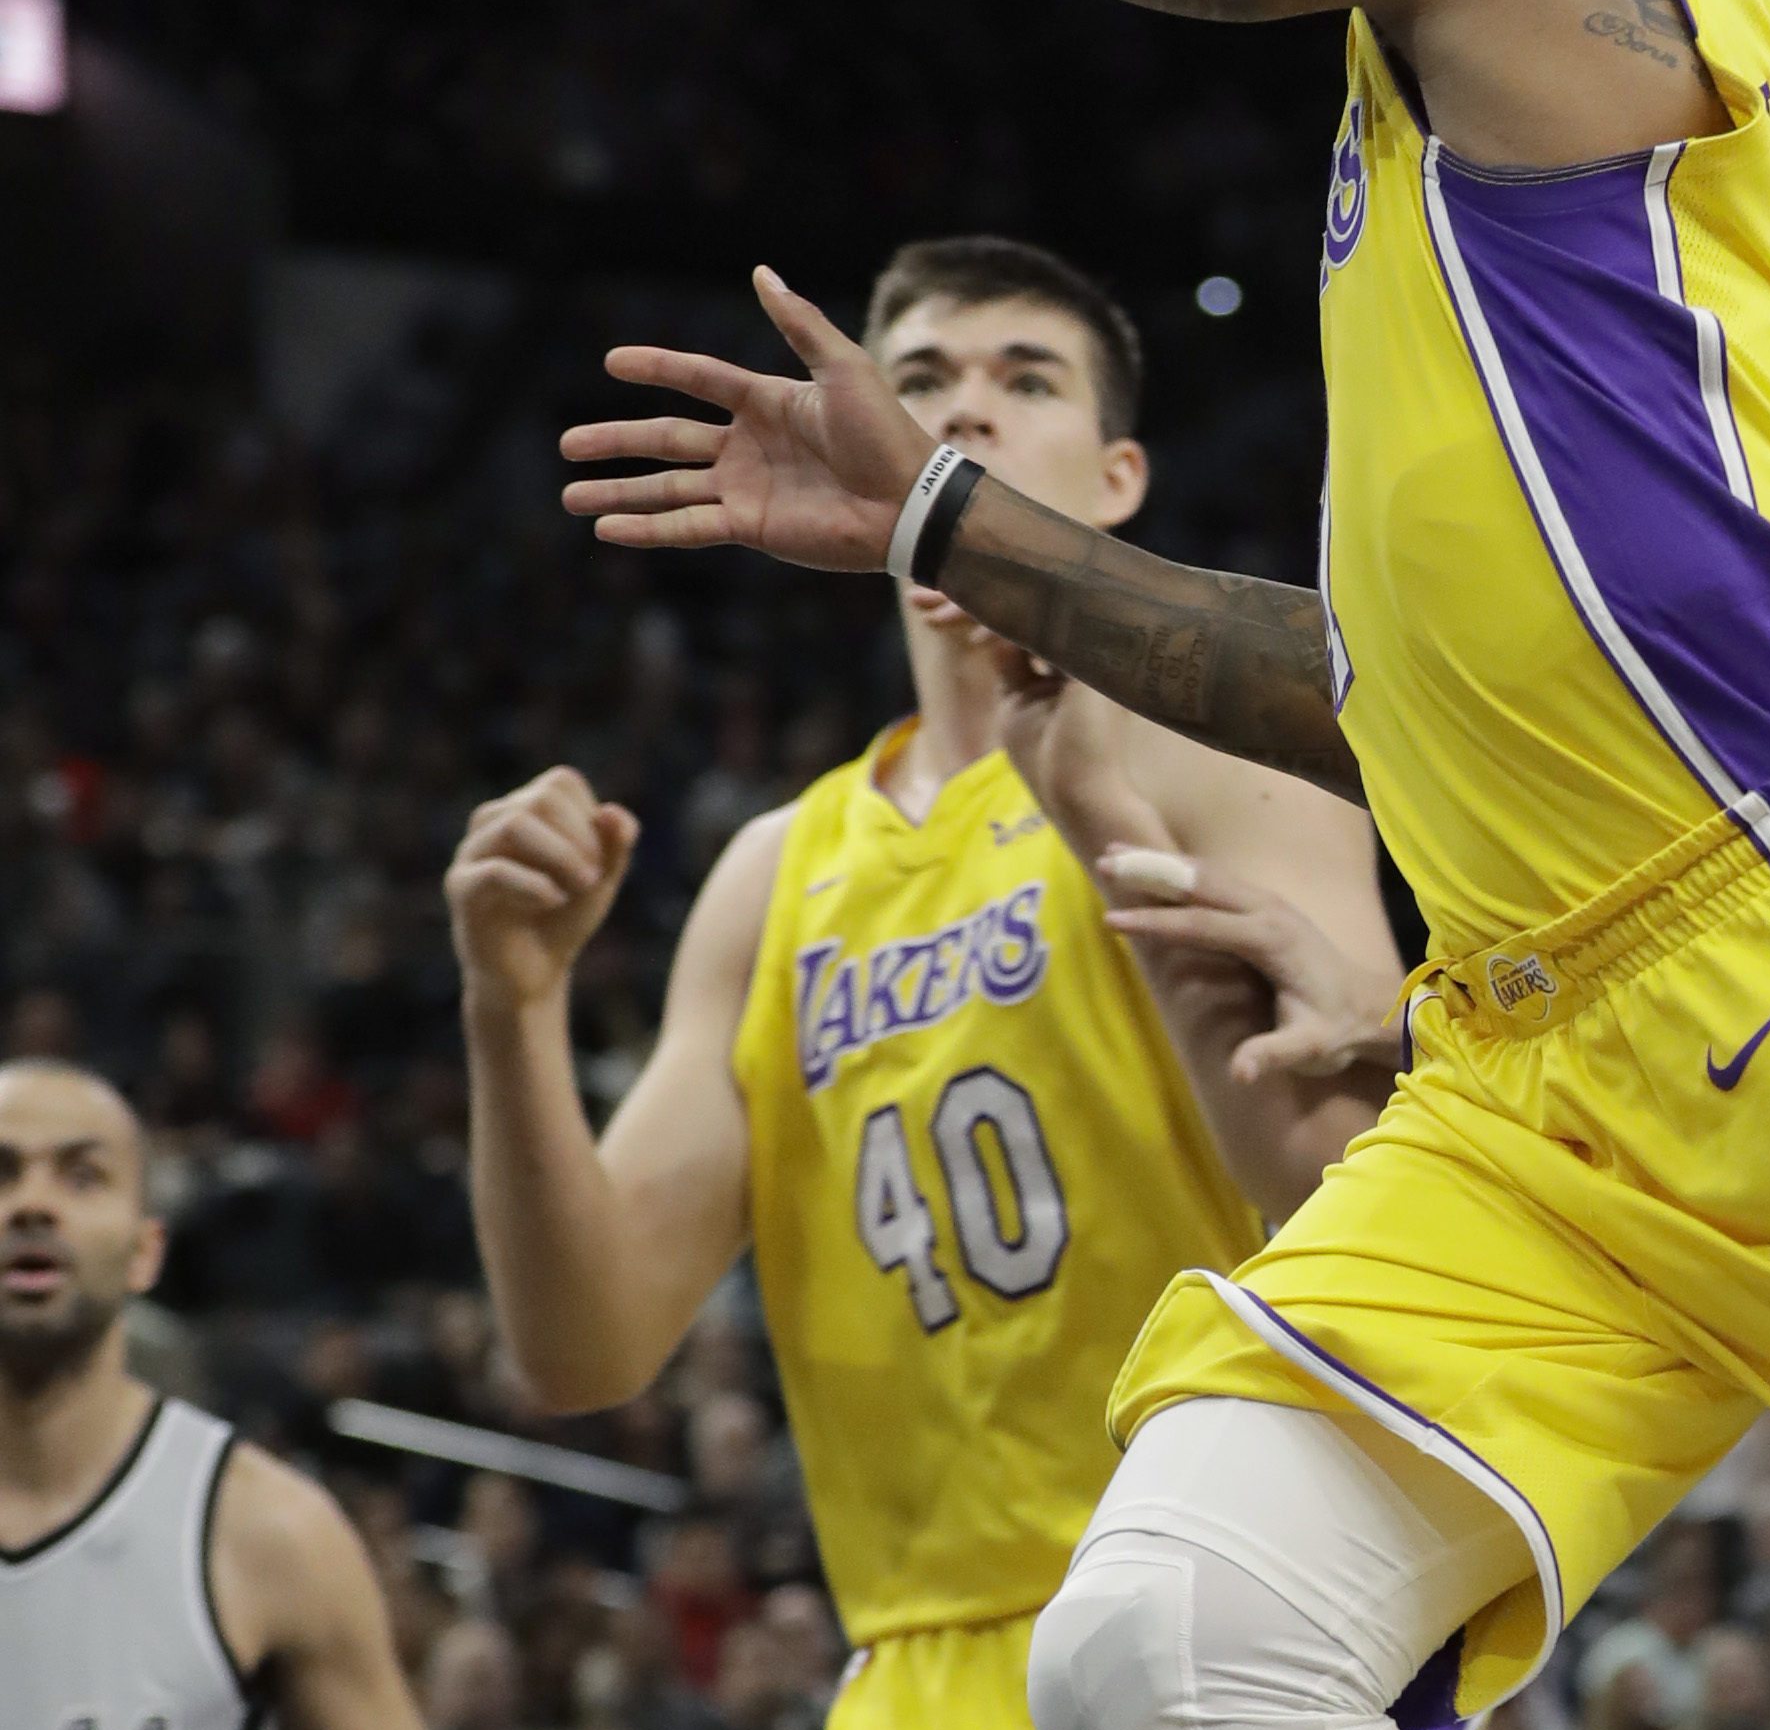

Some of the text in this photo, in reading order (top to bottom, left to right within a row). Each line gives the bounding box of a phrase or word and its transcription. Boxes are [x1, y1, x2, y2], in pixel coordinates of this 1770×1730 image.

[919, 448, 957, 497] JAIDEN
[796, 878, 1052, 1097] LAKERS
[854, 1064, 1071, 1337] 40
